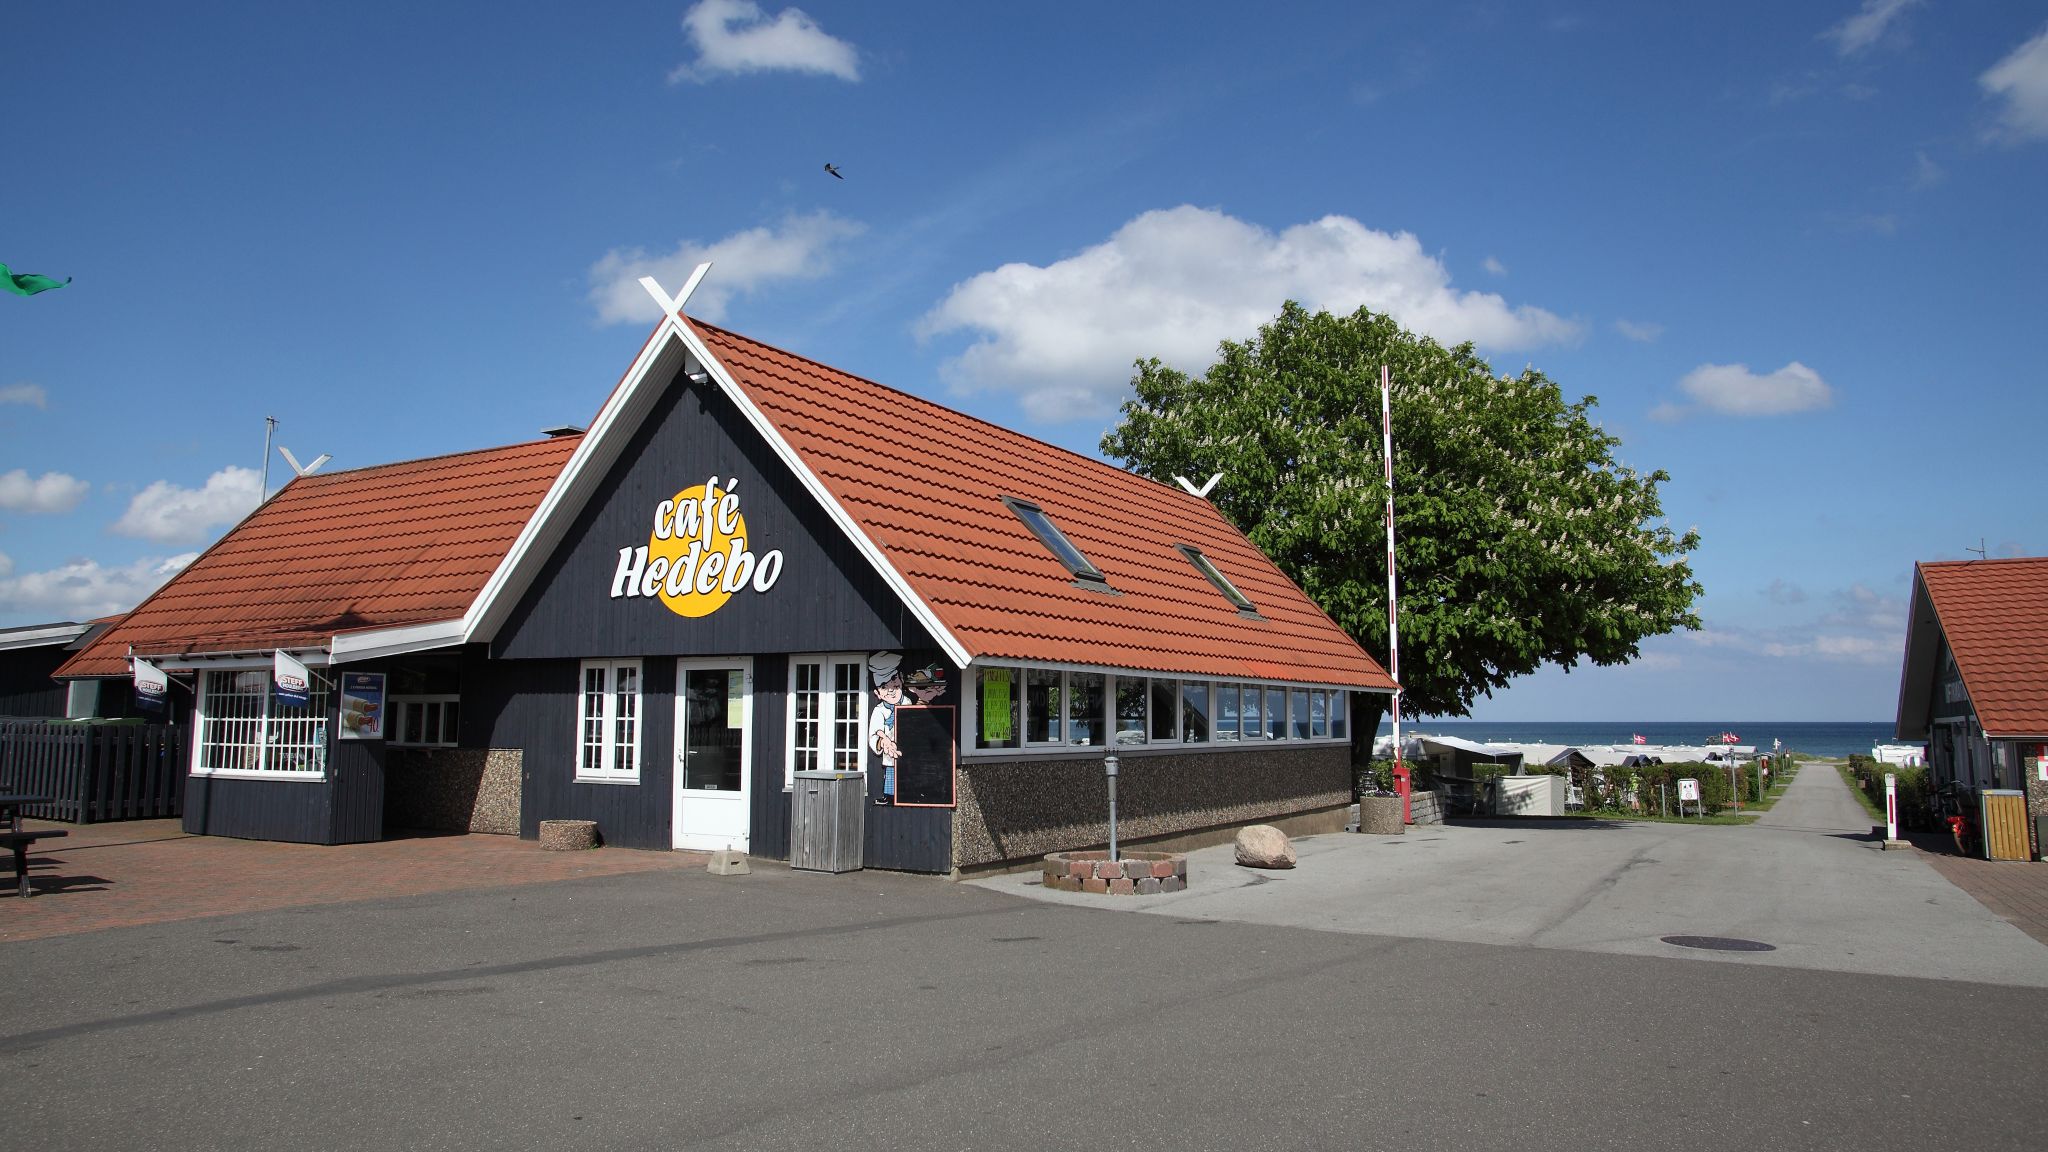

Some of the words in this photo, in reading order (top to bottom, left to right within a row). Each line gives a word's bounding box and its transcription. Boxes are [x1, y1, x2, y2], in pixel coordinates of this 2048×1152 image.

[653, 475, 741, 552] café
[610, 537, 784, 598] Hedebo
[141, 681, 161, 690] STEFF
[281, 677, 302, 686] STEFF
